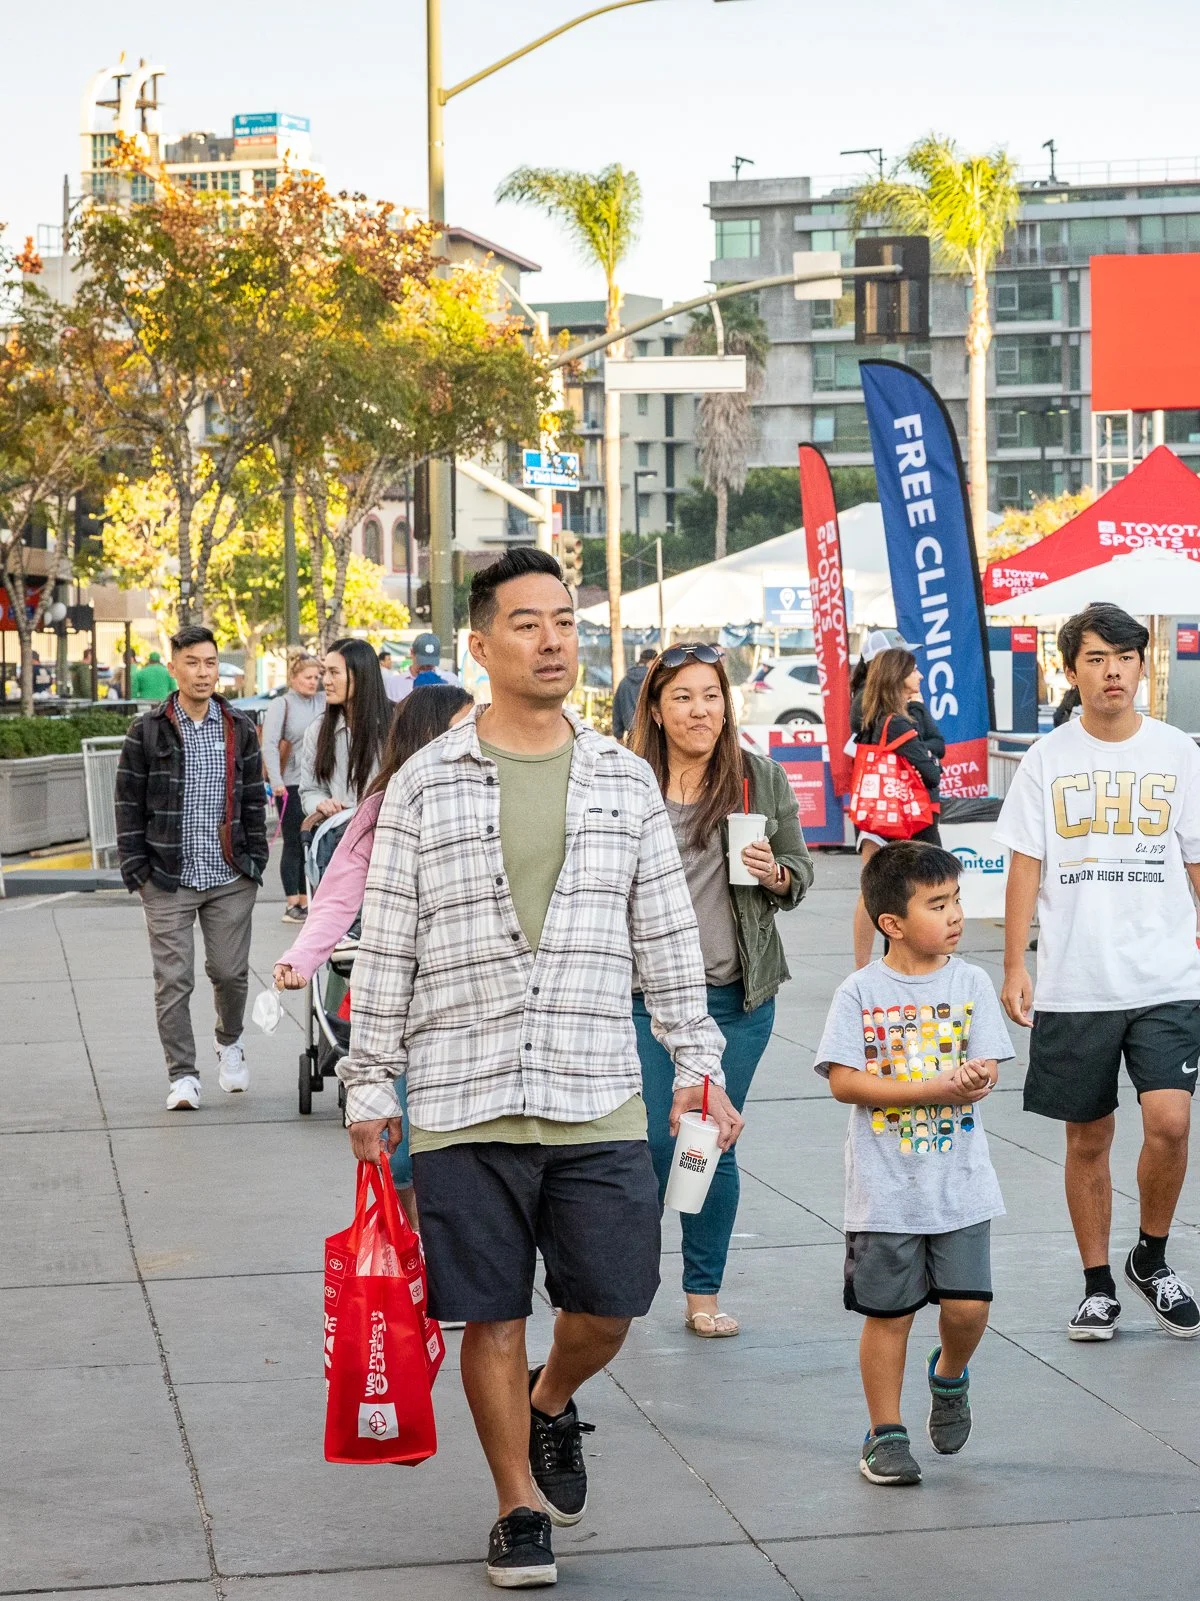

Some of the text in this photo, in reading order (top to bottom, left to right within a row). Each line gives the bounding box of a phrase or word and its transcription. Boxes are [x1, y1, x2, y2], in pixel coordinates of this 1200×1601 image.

[1100, 533, 1184, 549] SPORTS
[894, 413, 958, 721] FREE CLINICS
[1004, 568, 1048, 581] TOYOTA
[816, 525, 833, 632] SPORTS
[992, 577, 1034, 588] SPORTS
[828, 548, 847, 668] TOYOTA
[809, 577, 830, 698] FESTIVAL
[941, 761, 979, 777] YOTA
[939, 776, 963, 790] RTS
[939, 783, 989, 798] FESTIVA
[1051, 770, 1177, 839] CHS
[960, 855, 1004, 868] nited
[1060, 870, 1165, 884] CANON HIGH SCHOOL
[679, 1160, 706, 1173] BURGER
[370, 1310, 379, 1322] it
[369, 1324, 378, 1370] make
